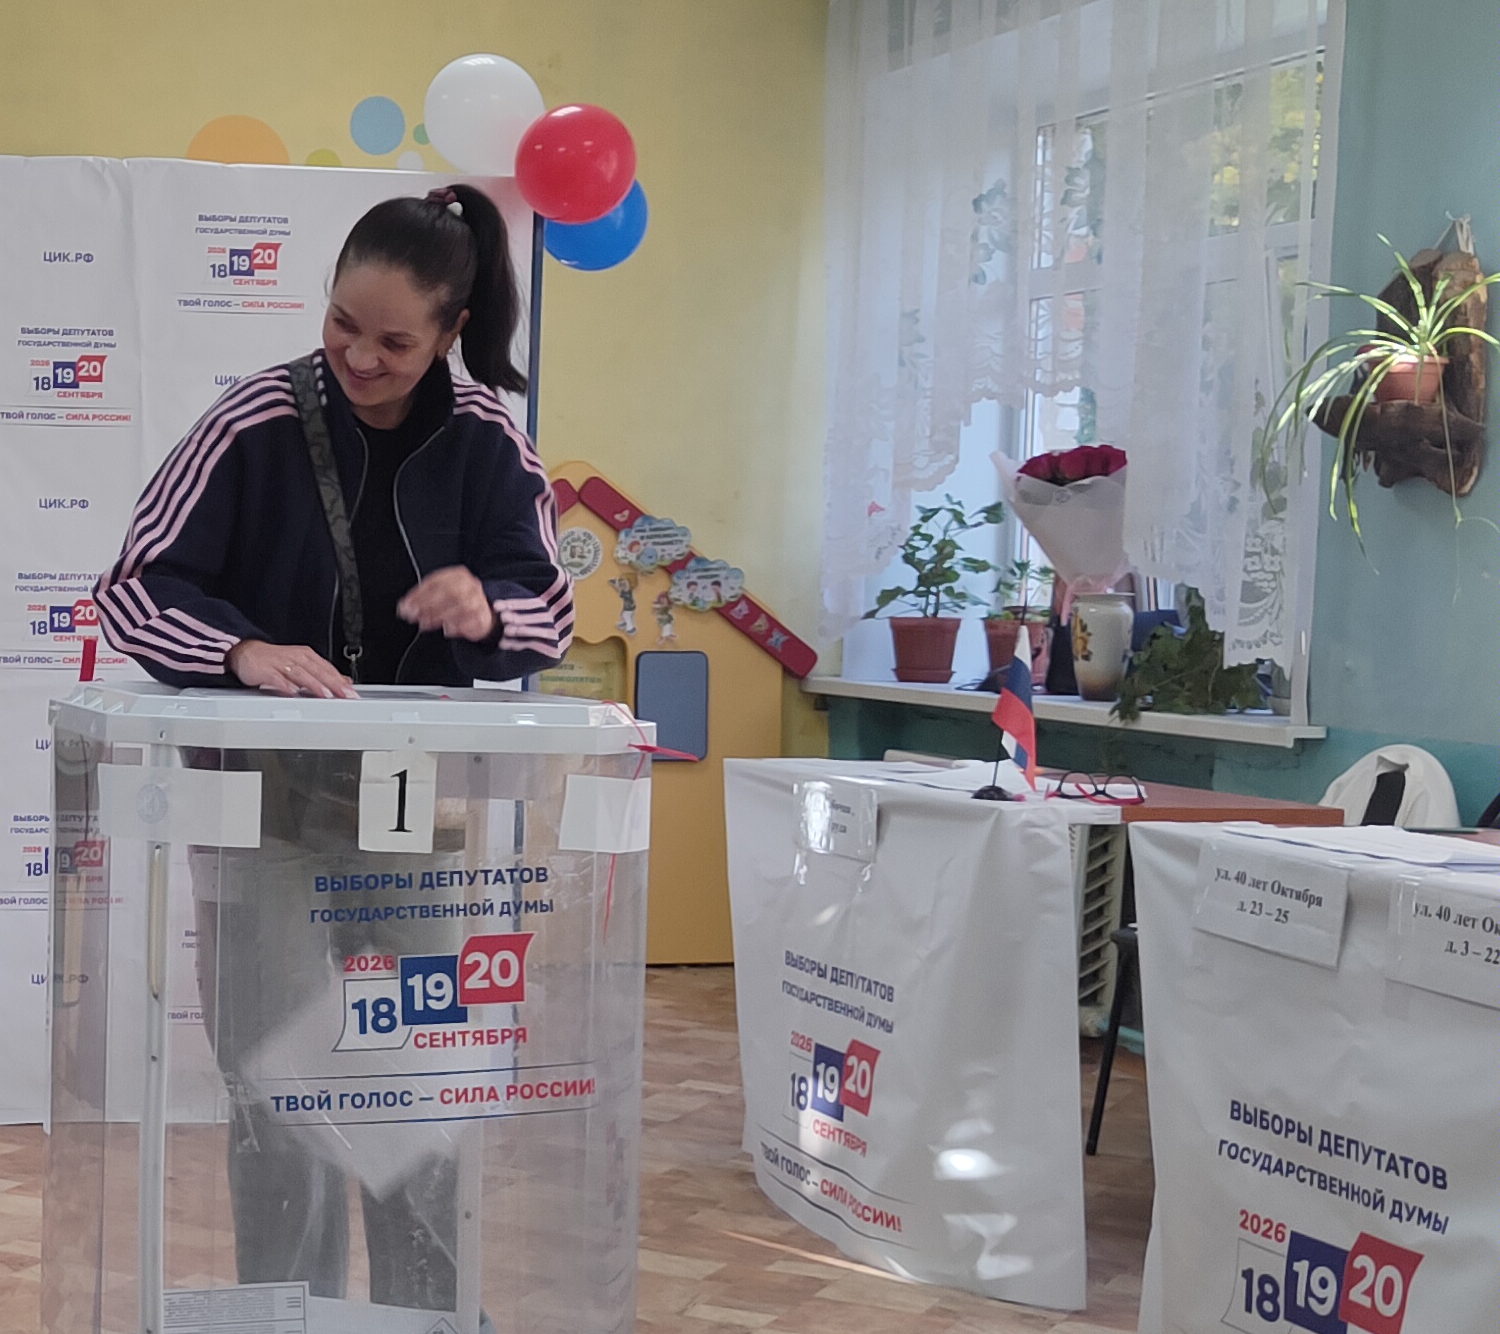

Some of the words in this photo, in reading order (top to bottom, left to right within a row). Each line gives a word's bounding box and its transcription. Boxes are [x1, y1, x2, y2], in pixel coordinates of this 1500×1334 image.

[43, 252, 94, 264] ЦИК.РФ
[210, 264, 227, 278] 18
[231, 256, 250, 270] 19
[253, 249, 275, 264] 20
[20, 327, 60, 335] ВЫБОРЫ
[62, 328, 114, 337] ДЕПУТАТОВ
[33, 377, 51, 391] 18
[55, 368, 74, 383] 19
[78, 361, 101, 376] 20
[214, 375, 241, 386] ЦИК
[0, 411, 24, 420] ТВОЙ
[26, 412, 56, 420] ГОЛОС
[65, 413, 90, 421] СИЛА
[92, 414, 131, 422] РОССИИ!
[39, 498, 89, 509] ЦИК.РФ
[15, 585, 89, 593] ГОСУДАРСТВЕННОЙ
[59, 573, 100, 581] ДЕПУТАТ
[29, 621, 48, 635] 18
[52, 612, 70, 627] 19
[74, 605, 96, 621] 20
[389, 768, 412, 832] 1
[25, 862, 42, 876] 18
[315, 873, 412, 893] ВЫБОРЫ
[420, 868, 548, 890] ДЕПУТАТОВ
[1214, 867, 1231, 881] ул.
[1234, 869, 1247, 885] 40
[1248, 876, 1268, 892] лет
[1270, 879, 1323, 908] Октября
[310, 899, 493, 923] ГОСУДАРСТВЕННОЙ
[499, 899, 554, 918] ДУМЫ
[1236, 900, 1248, 912] д.
[1250, 900, 1263, 917] 23
[1276, 908, 1290, 925] 25
[1412, 900, 1432, 918] ул.
[1436, 905, 1451, 923] 40
[1453, 911, 1479, 929] лет
[1445, 940, 1458, 954] д.
[1461, 941, 1469, 956] 3
[344, 955, 394, 972] 2026
[785, 950, 827, 979] ВЫБОРЫ
[830, 966, 894, 1002] ДЕПУТАТОВ
[352, 998, 396, 1034] 18
[406, 973, 453, 1010] 19
[463, 951, 519, 988] 20
[782, 980, 865, 1024] ГОСУДАРСТВЕННОЙ
[866, 1012, 894, 1034] ДУМЫ
[414, 1028, 527, 1048] СЕНТЯБРЯ
[791, 1030, 812, 1052] 2026
[270, 1090, 331, 1112] ТВОЙ
[339, 1091, 412, 1108] ГОЛОС
[440, 1085, 499, 1104] СИЛА
[506, 1078, 595, 1100] РОССИИ!
[791, 1073, 809, 1110] 18
[816, 1063, 838, 1103] 19
[844, 1055, 871, 1098] 20
[813, 1119, 867, 1158] СЕНТЯБРЯ
[1230, 1099, 1312, 1147] ВЫБОРЫ
[1318, 1129, 1447, 1190] ДЕПУТАТОВ
[781, 1156, 811, 1185] ГОЛОС
[821, 1178, 847, 1206] СИЛА
[1218, 1139, 1385, 1214] ГОСУДАРСТВЕННОЙ
[1389, 1199, 1449, 1235] ДУМЫ
[1240, 1209, 1286, 1243] 2026
[1242, 1267, 1280, 1323] 18
[1293, 1260, 1338, 1317] 19
[1349, 1254, 1404, 1318] 20
